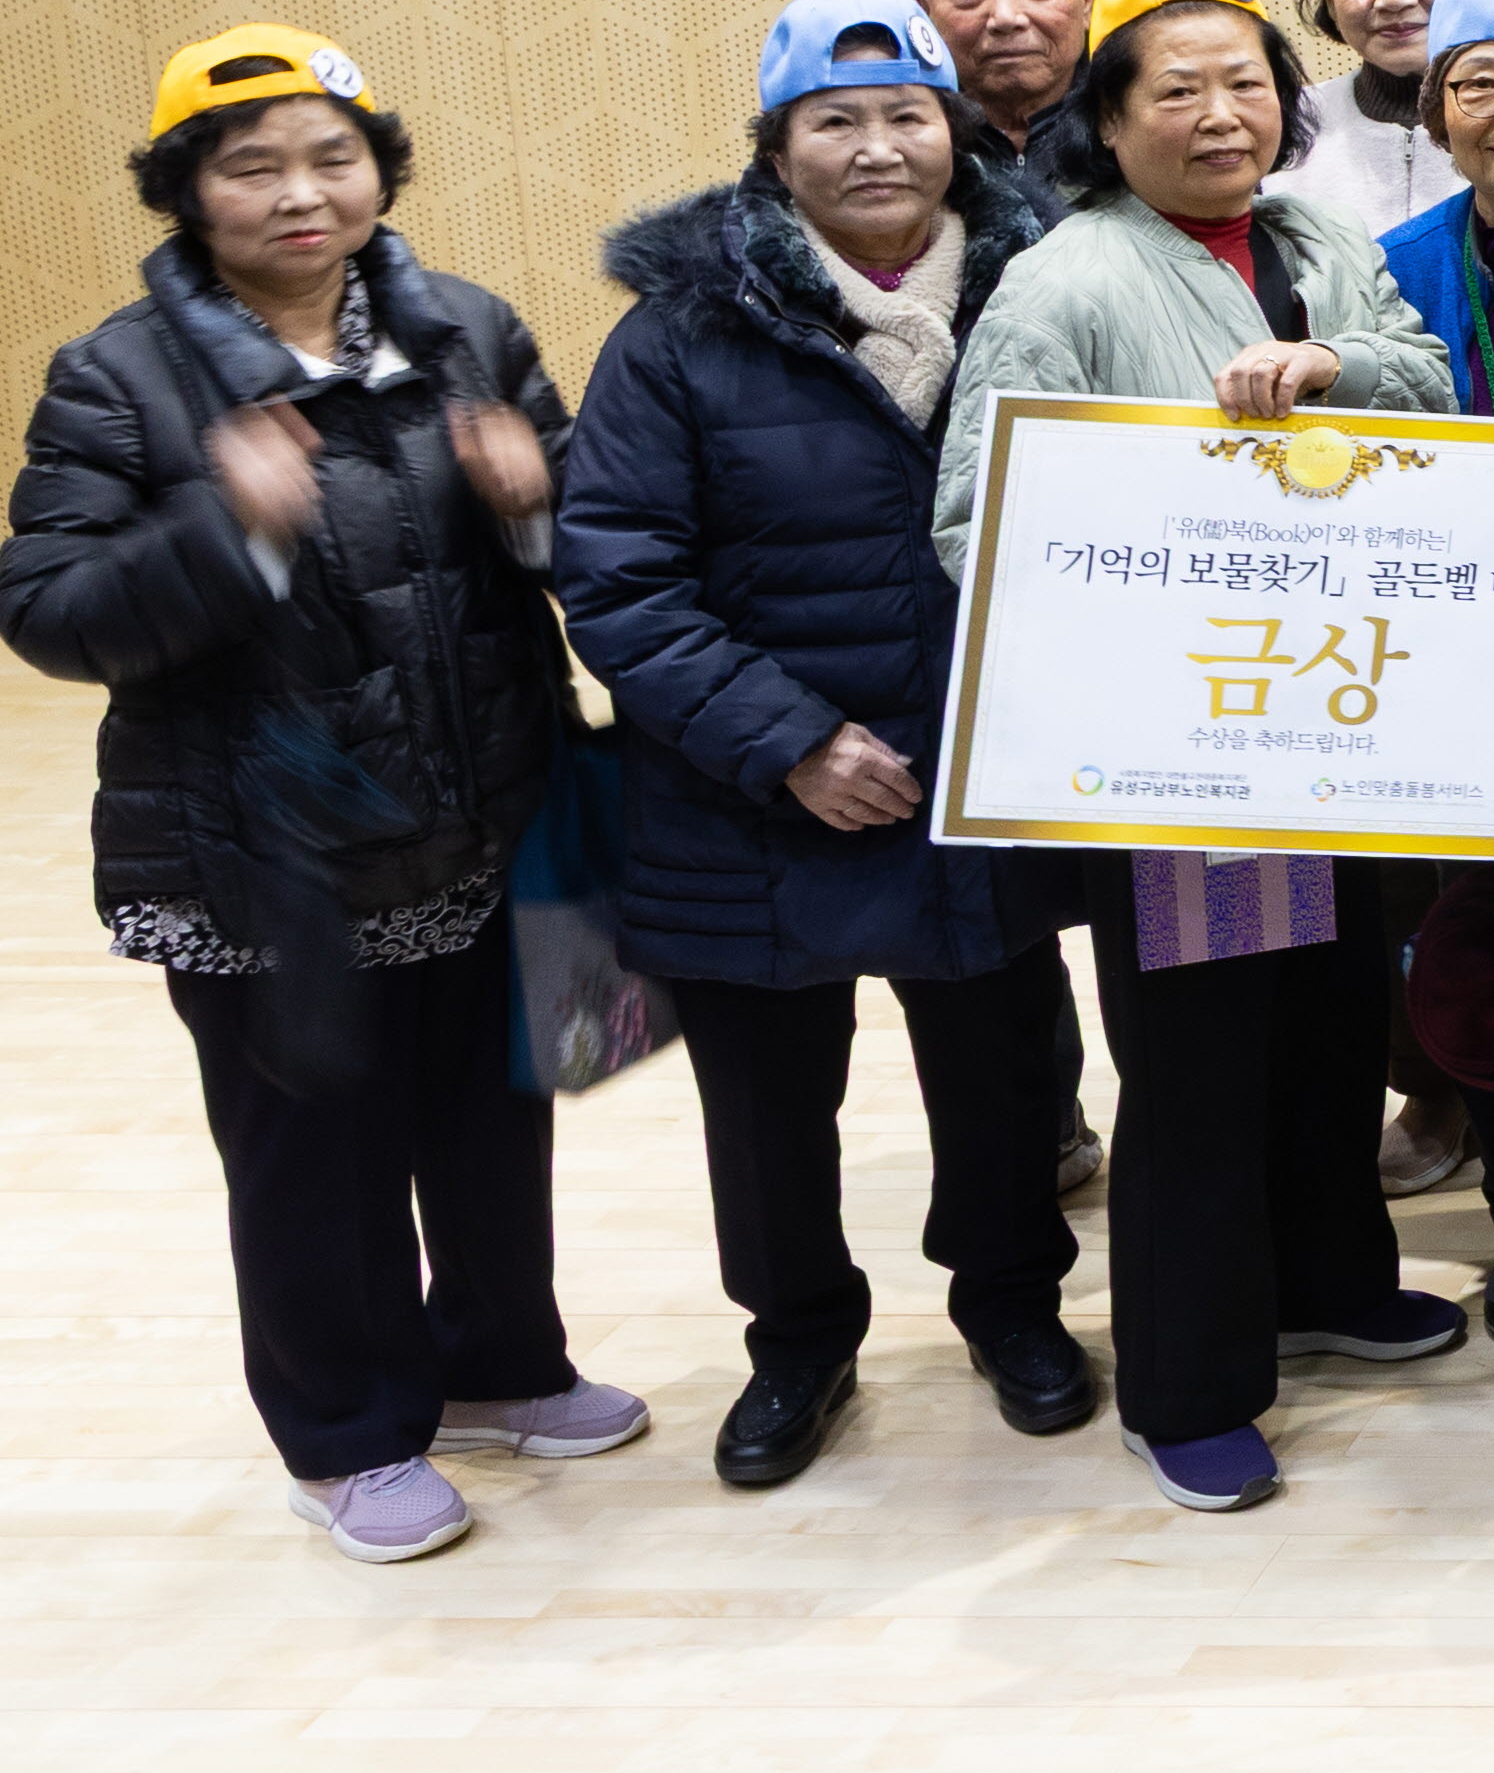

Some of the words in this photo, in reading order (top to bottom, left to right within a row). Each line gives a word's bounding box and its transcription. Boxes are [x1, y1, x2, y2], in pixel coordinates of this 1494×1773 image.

[1364, 527, 1447, 551] 함께하는
[1045, 541, 1170, 587] 「기억의
[1180, 551, 1347, 598] 보물찾기」
[1366, 560, 1478, 603] 골든벨
[1186, 615, 1410, 726] 금상
[1187, 726, 1250, 751] 수상을
[1254, 729, 1380, 756] 축하드립니다.
[1110, 780, 1251, 801] 유성구남부노인복지관
[1339, 779, 1485, 799] 노인맞춤돌봄서비스
